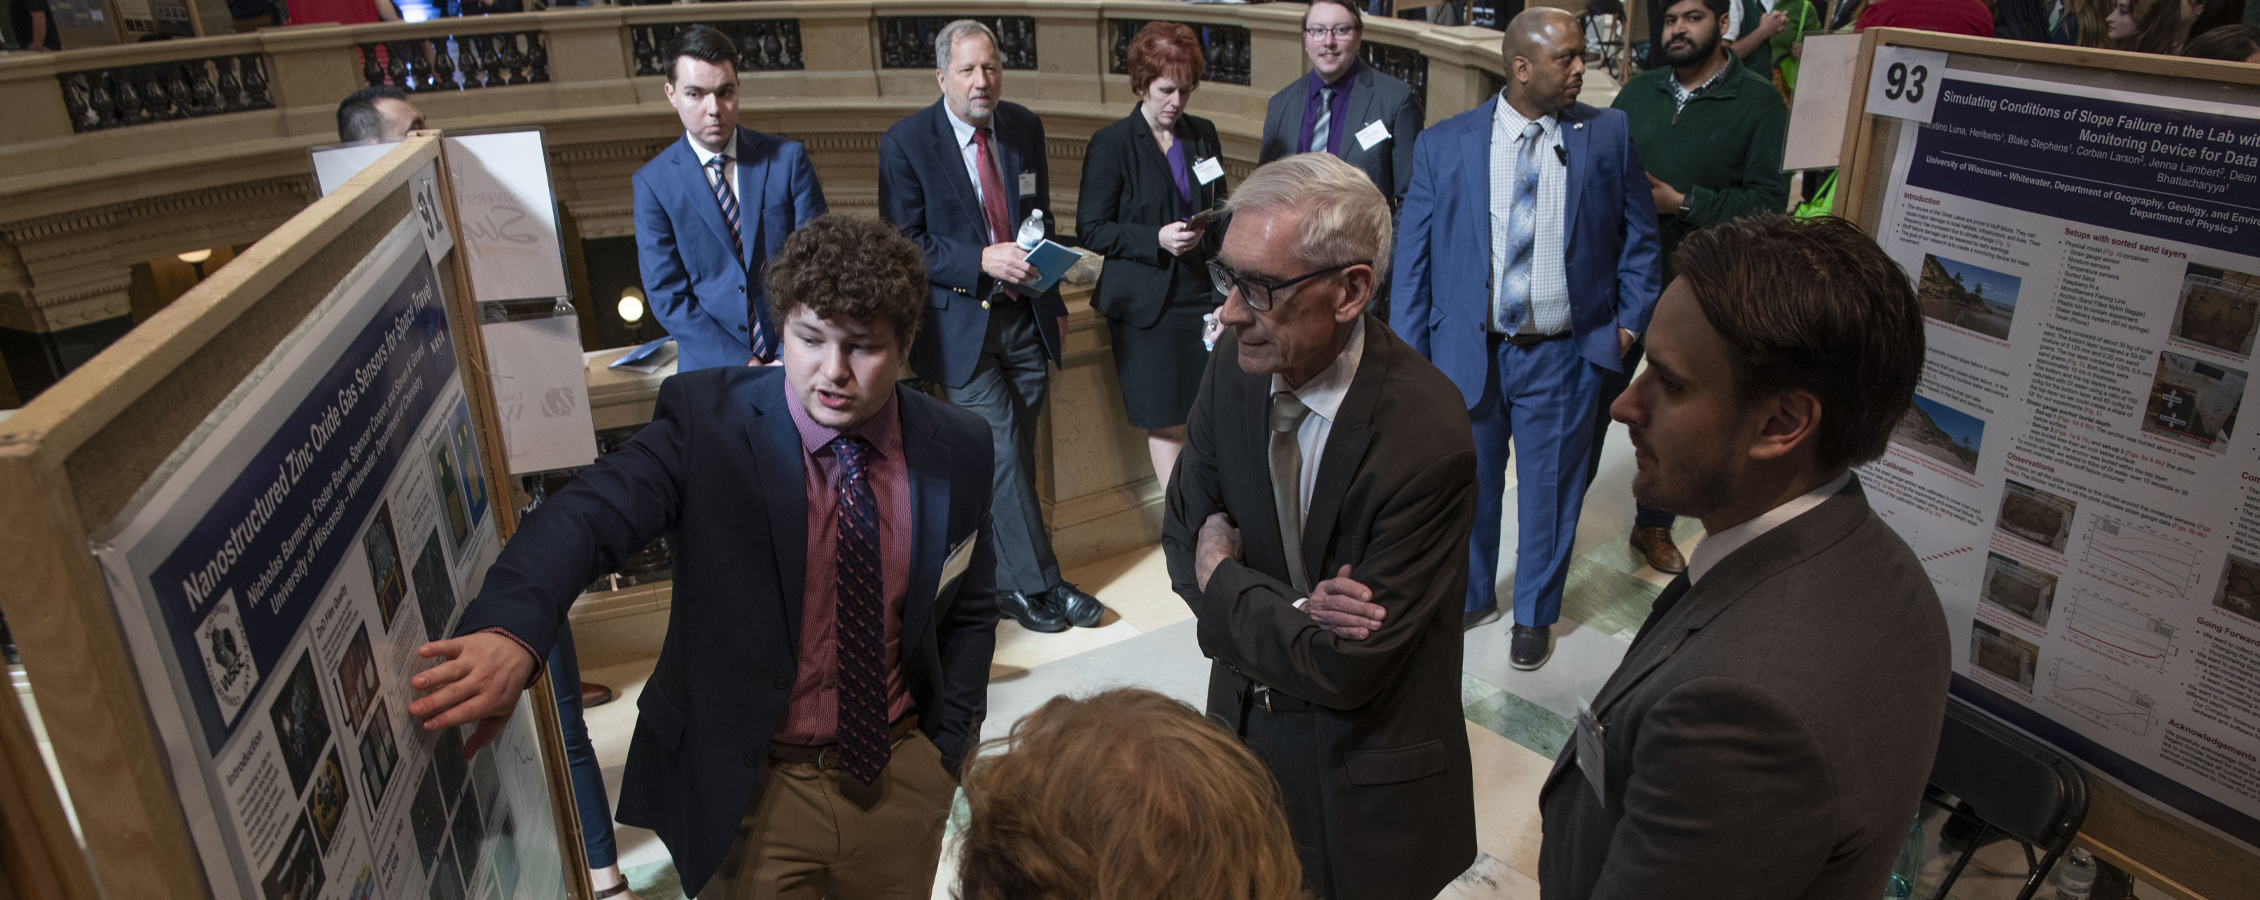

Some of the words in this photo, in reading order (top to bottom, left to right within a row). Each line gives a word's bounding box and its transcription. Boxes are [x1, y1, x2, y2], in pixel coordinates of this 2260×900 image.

[1885, 62, 1928, 103] 93
[1943, 90, 1997, 112] Simulating
[1999, 98, 2061, 118] Conditions
[2063, 109, 2077, 121] of
[2078, 110, 2114, 128] Slope
[2117, 115, 2162, 133] Failure
[2165, 122, 2179, 136] in
[2181, 124, 2205, 139] the
[2207, 127, 2236, 144] Lab
[2008, 134, 2029, 145] Blake
[2076, 146, 2108, 159] Corban
[2149, 157, 2178, 170] Jenna
[2229, 170, 2257, 183] Dean
[2079, 129, 2148, 154] Monitoring
[2150, 140, 2197, 158] Device
[2200, 147, 2222, 162] for
[2223, 151, 2259, 168] Data
[1903, 192, 1941, 206] Introduction
[1926, 155, 1958, 170] University
[1967, 164, 2002, 177] Wisconsin
[2009, 172, 2052, 189] Whitewater,
[2054, 181, 2102, 197] Department
[2103, 190, 2113, 199] of
[2114, 191, 2164, 210] Geography,
[2167, 201, 2208, 218] Geology,
[2211, 211, 2230, 220] and
[418, 184, 443, 240] 91
[2130, 207, 2184, 224] Department
[2184, 218, 2196, 227] of
[2064, 228, 2091, 240] Setups
[2093, 235, 2110, 243] with
[2111, 239, 2138, 249] sorted
[2139, 244, 2160, 253] sand
[2161, 247, 2187, 259] layers
[2064, 271, 2081, 279] Sorted
[2066, 264, 2098, 275] Temperature
[2098, 272, 2120, 280] sensors
[2068, 257, 2090, 266] Moisture
[2061, 285, 2094, 297] Monofilament
[2095, 293, 2114, 303] Fishing
[2062, 278, 2088, 289] Raspberry
[2059, 293, 2077, 301] Anchor
[2077, 297, 2093, 305] (Sand
[2108, 304, 2124, 312] Nylon
[2125, 308, 2146, 318] Baggie)
[2089, 308, 2108, 316] contain
[2069, 317, 2089, 327] (Phone)
[2071, 311, 2091, 320] delivery
[2092, 316, 2110, 324] system
[2128, 325, 2150, 335] syringe)
[183, 463, 290, 615] Nanostructured
[286, 439, 313, 487] Zinc
[310, 403, 341, 455] Oxide
[338, 381, 358, 419] Gas
[355, 342, 388, 396] Sensors
[385, 328, 397, 356] for
[395, 304, 415, 344] Space
[413, 275, 432, 317] Travel
[1882, 459, 1914, 476] Calibration
[2007, 452, 2055, 473] Observations
[247, 553, 283, 610] Nicholas
[281, 513, 314, 561] Barmore,
[312, 481, 333, 518] Foster
[332, 458, 352, 489] Boom,
[350, 426, 371, 463] Spencer
[395, 369, 408, 395] Steven
[271, 555, 308, 617] University
[307, 540, 315, 563] of
[314, 499, 345, 552] Wisconsin
[376, 411, 400, 456] Department
[400, 403, 404, 419] of
[403, 376, 423, 412] Chemistry
[326, 606, 334, 624] Film
[334, 585, 347, 609] Quality
[2196, 617, 2223, 634] Going
[2168, 718, 2257, 763] Acknowledgements
[227, 730, 262, 787] Introduction
[382, 841, 395, 876] Analysis
